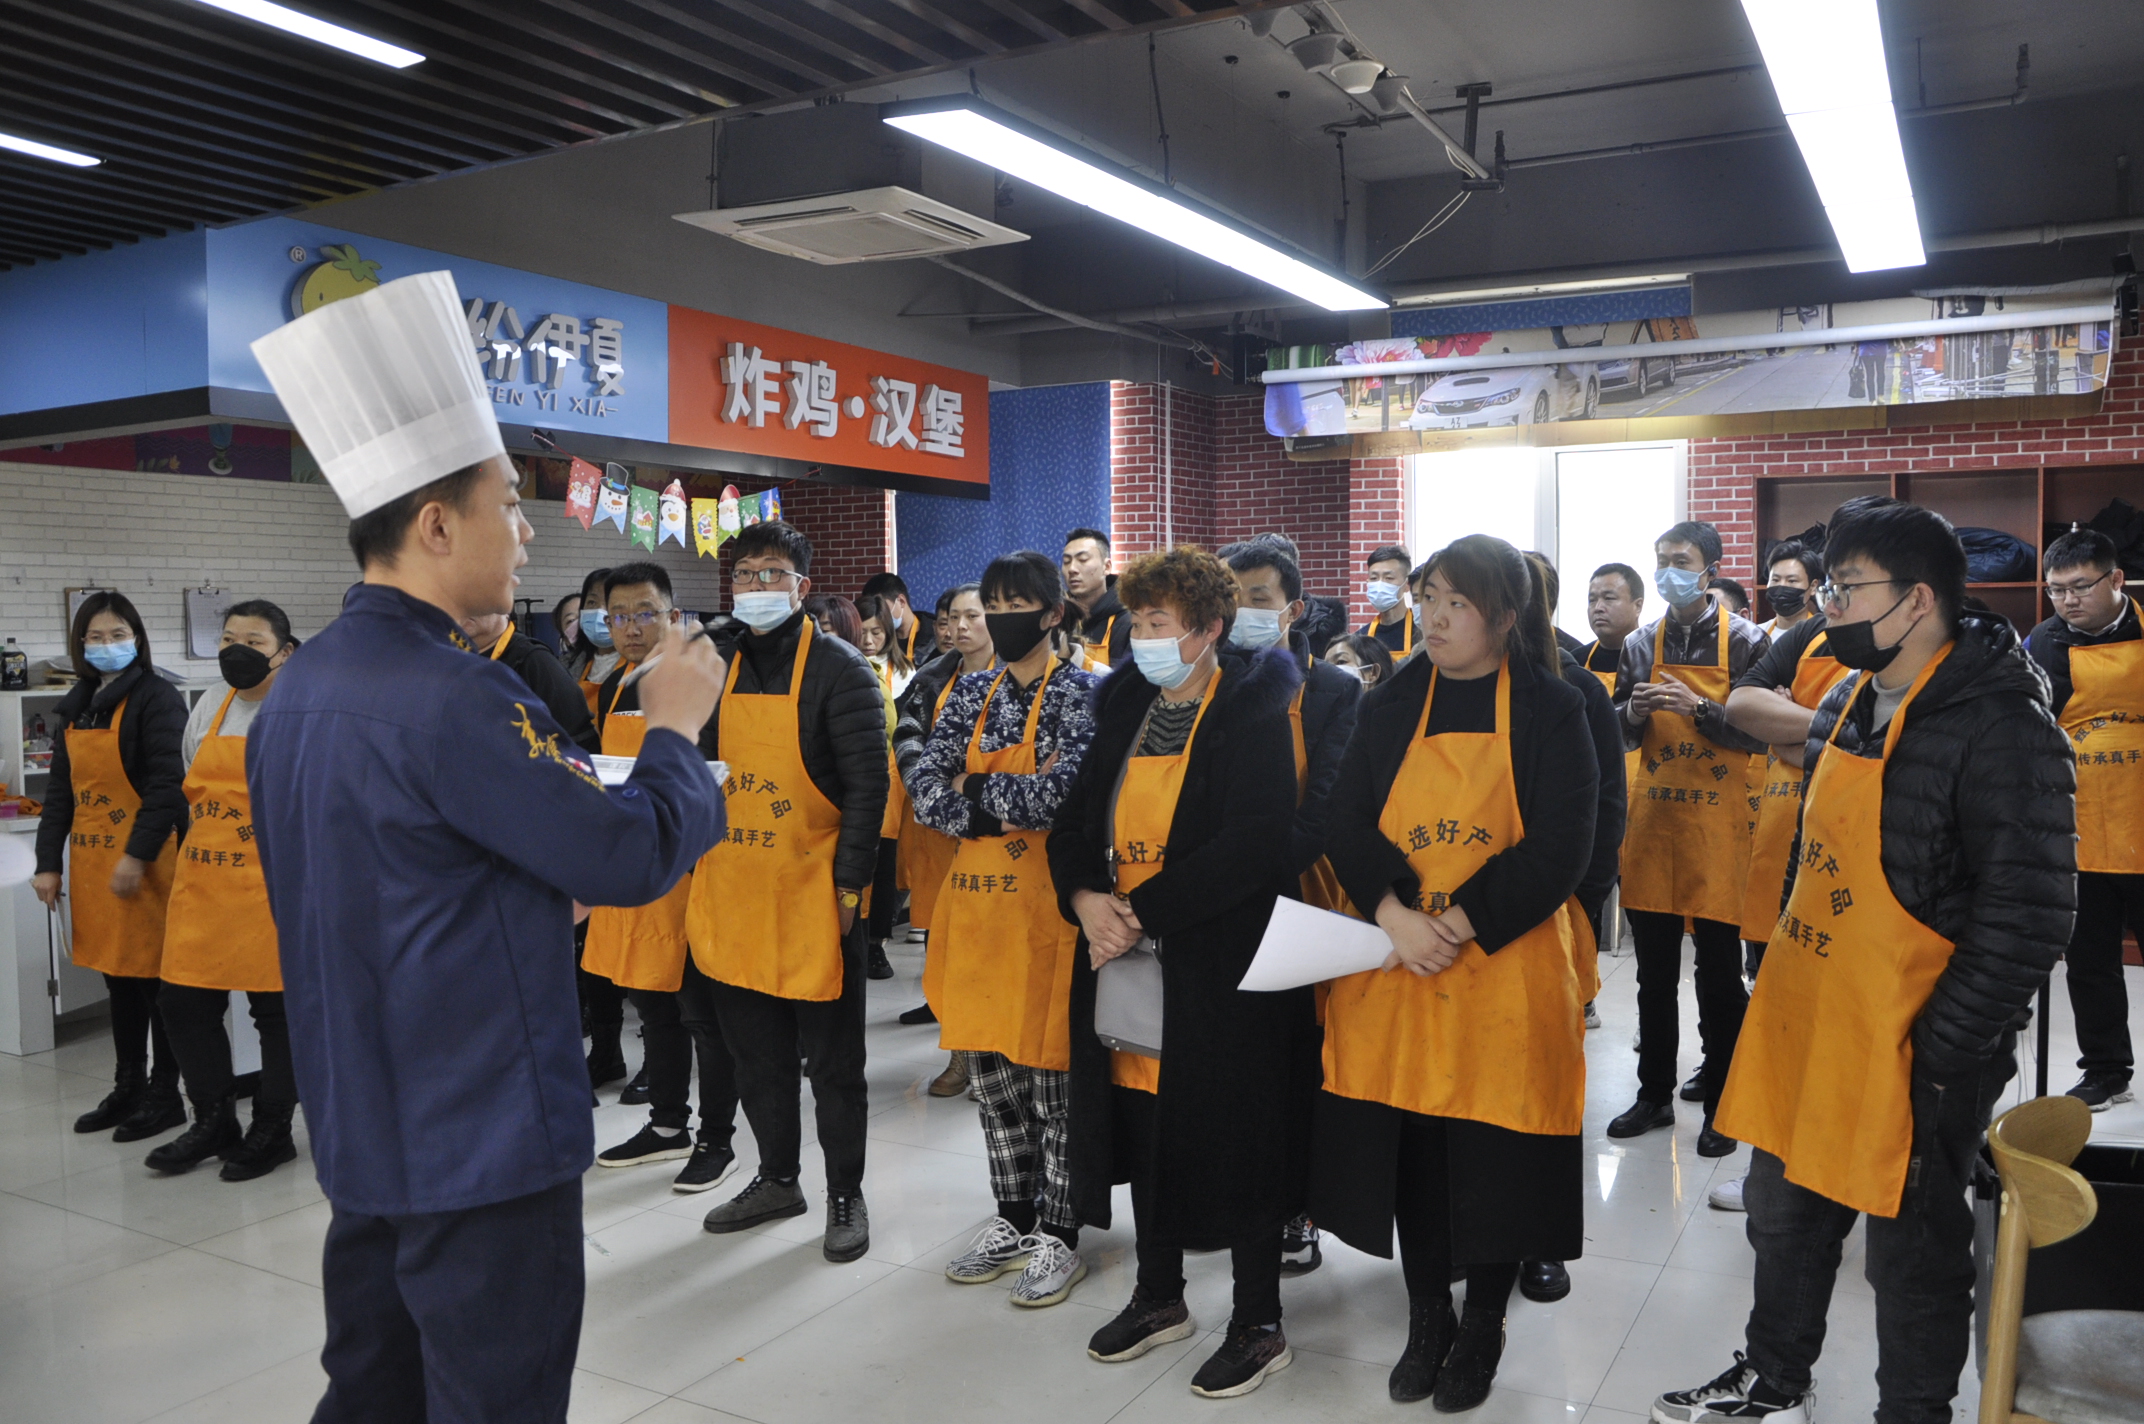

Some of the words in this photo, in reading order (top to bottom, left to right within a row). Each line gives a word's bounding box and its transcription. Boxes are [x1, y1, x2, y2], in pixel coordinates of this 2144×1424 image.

[534, 390, 559, 411] YI
[720, 342, 965, 457] 炸鸡·汉堡
[1646, 741, 1729, 781] 甄选好产品
[2078, 749, 2142, 767] 传承真手
[722, 771, 793, 819] 选好产品
[1647, 786, 1720, 806] 传承真手艺
[1764, 781, 1802, 798] 承真手
[71, 832, 116, 848] 承真手艺
[189, 799, 255, 842] 选好产品
[1394, 818, 1493, 858] 选好产
[1779, 910, 1833, 958] 承真手艺
